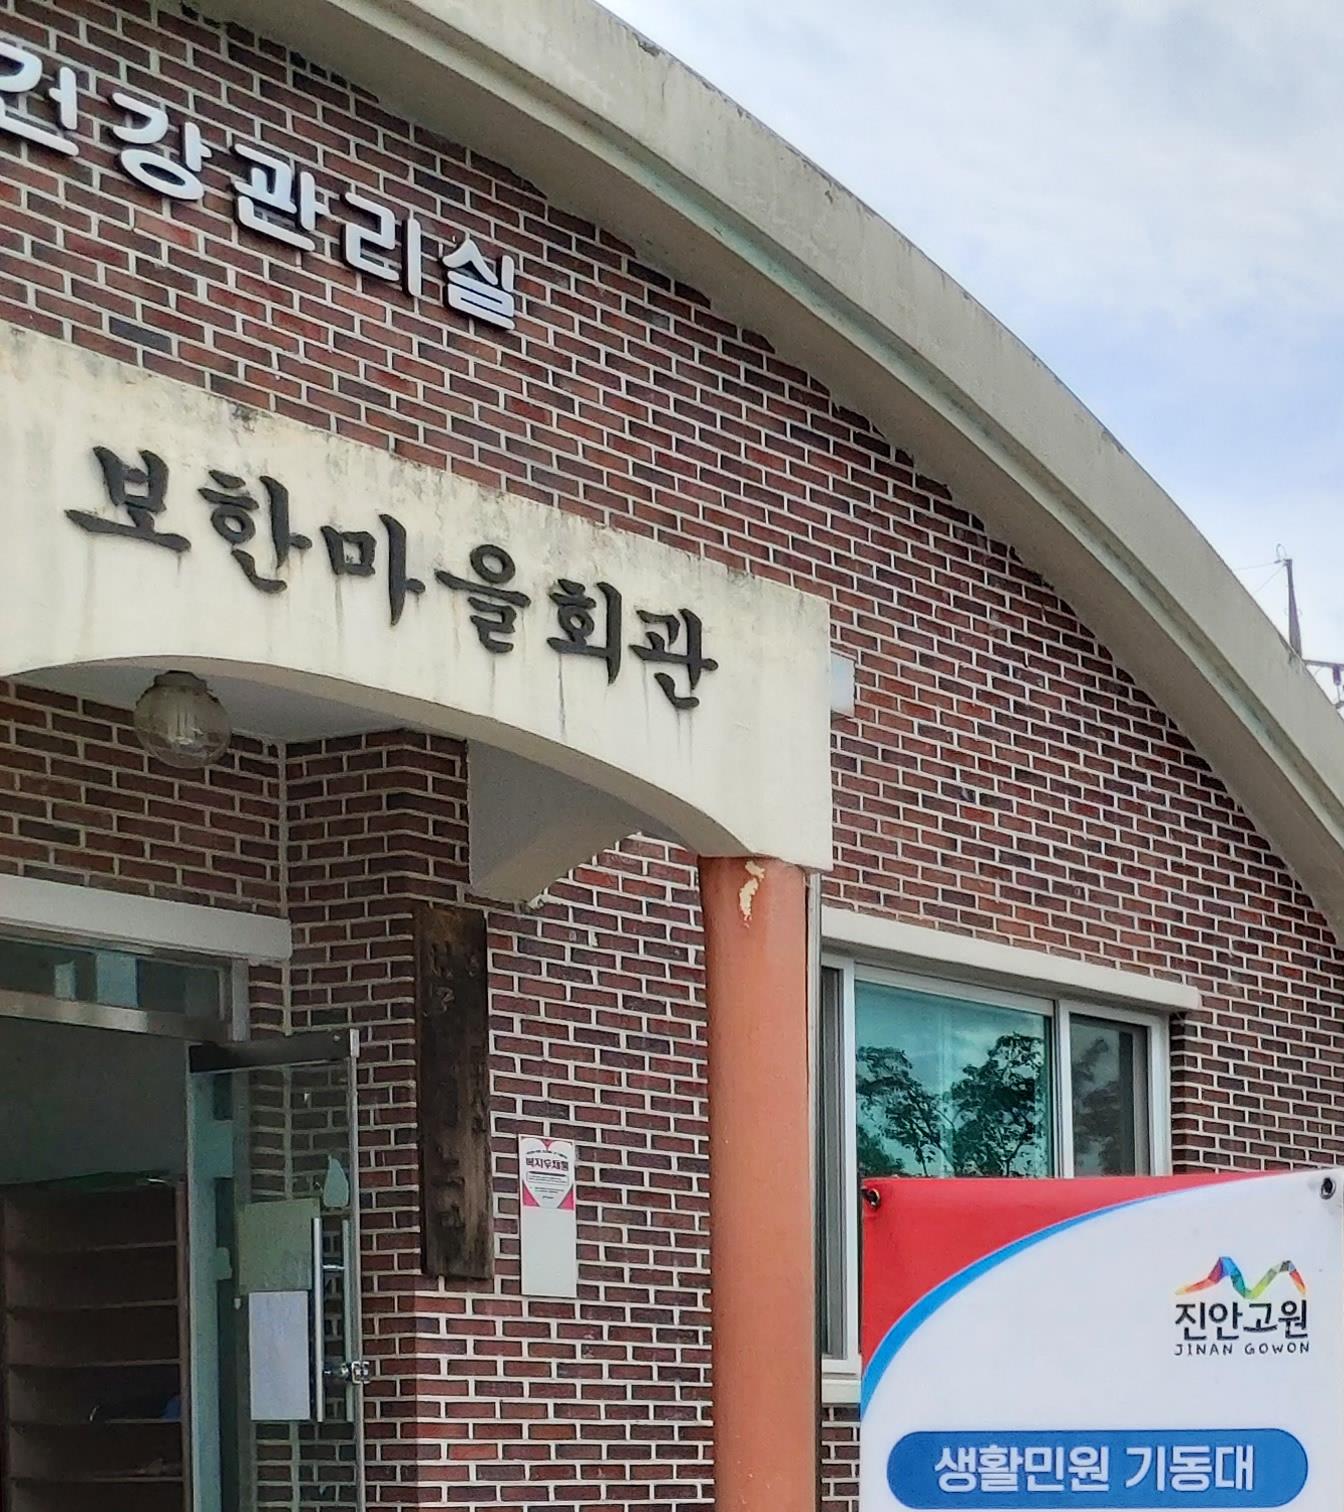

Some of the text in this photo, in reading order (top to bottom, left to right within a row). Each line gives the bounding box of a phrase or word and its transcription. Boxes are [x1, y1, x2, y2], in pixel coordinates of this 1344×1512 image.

[0, 40, 517, 331] 건강관리실
[64, 445, 720, 709] 보한마을회관
[1174, 1299, 1309, 1341] 진안고원
[1174, 1340, 1310, 1356] JINAN GOWON
[934, 1444, 1254, 1493] 생활민원 기동대
